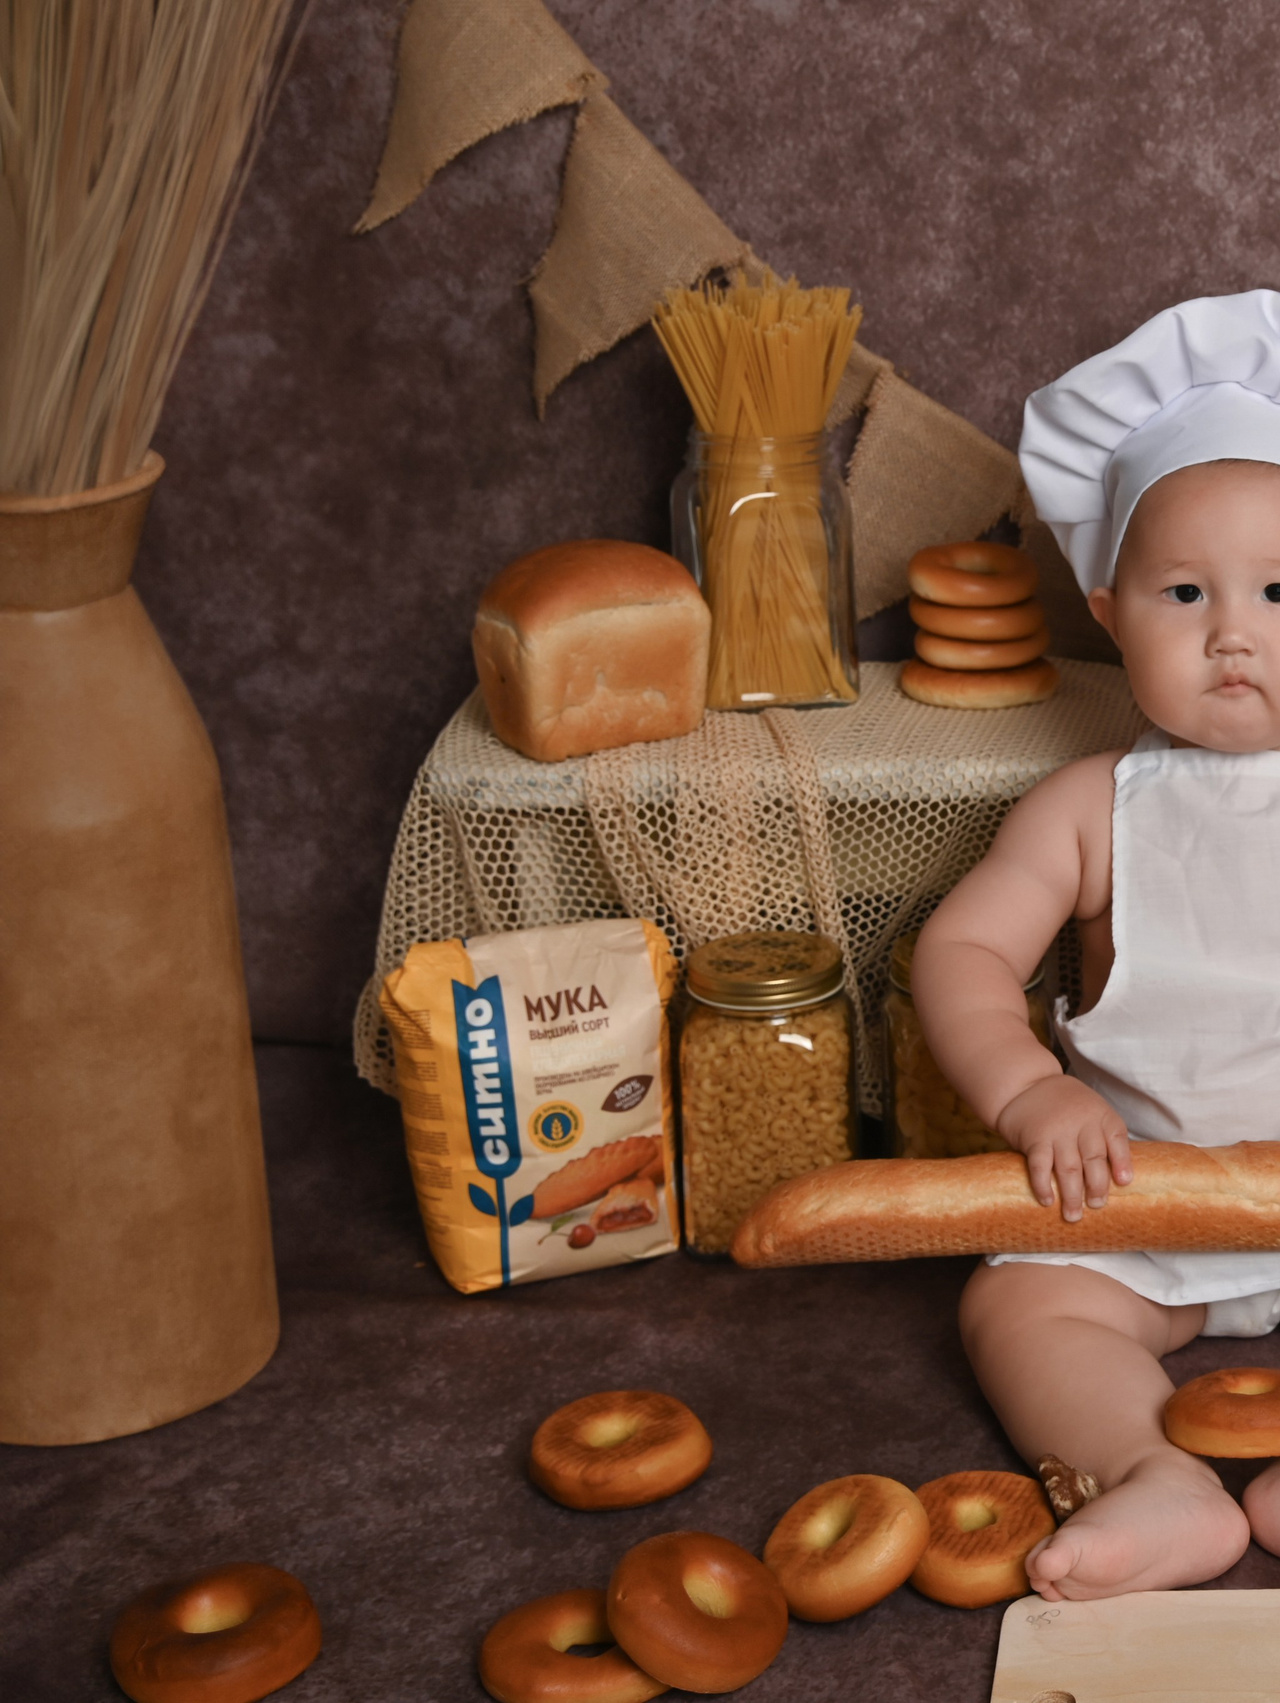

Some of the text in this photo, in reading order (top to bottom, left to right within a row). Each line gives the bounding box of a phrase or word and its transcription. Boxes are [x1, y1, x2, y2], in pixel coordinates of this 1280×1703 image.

[523, 984, 609, 1023] МУКА
[582, 1017, 610, 1033] СОРТ
[465, 998, 511, 1166] ситно
[613, 1080, 642, 1101] 100%
